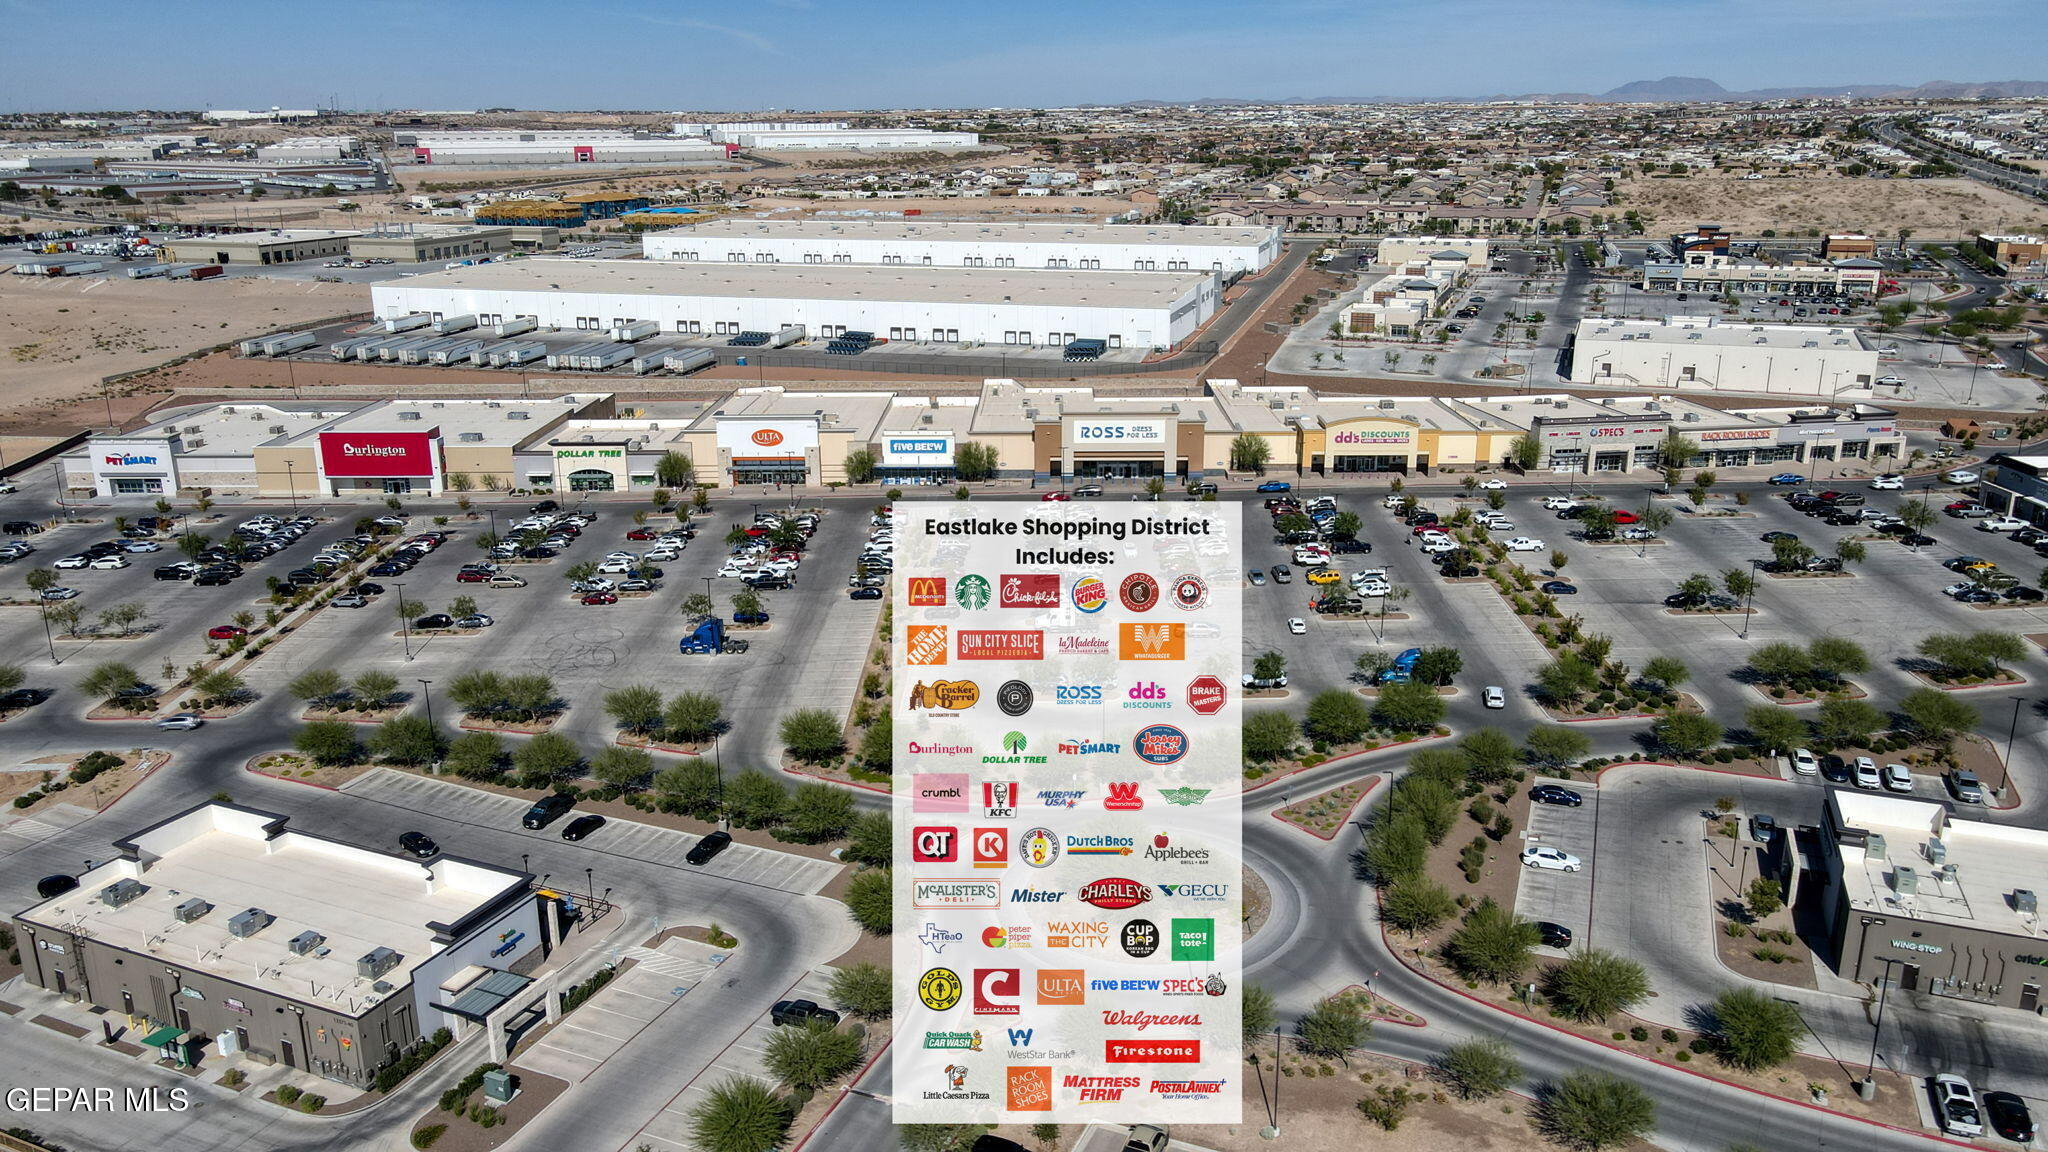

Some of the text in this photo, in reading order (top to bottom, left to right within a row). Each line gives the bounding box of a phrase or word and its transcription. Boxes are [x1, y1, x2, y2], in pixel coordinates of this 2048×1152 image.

[756, 432, 780, 441] ULTA
[1080, 426, 1124, 438] ROSS
[1598, 428, 1625, 437] SPEC'S
[1702, 432, 1722, 440] RACK
[1748, 430, 1771, 438] SHOES
[1334, 431, 1360, 443] dd's
[343, 443, 406, 457] Burlington
[893, 442, 944, 451] five BELOW
[557, 450, 594, 458] DOLLAR
